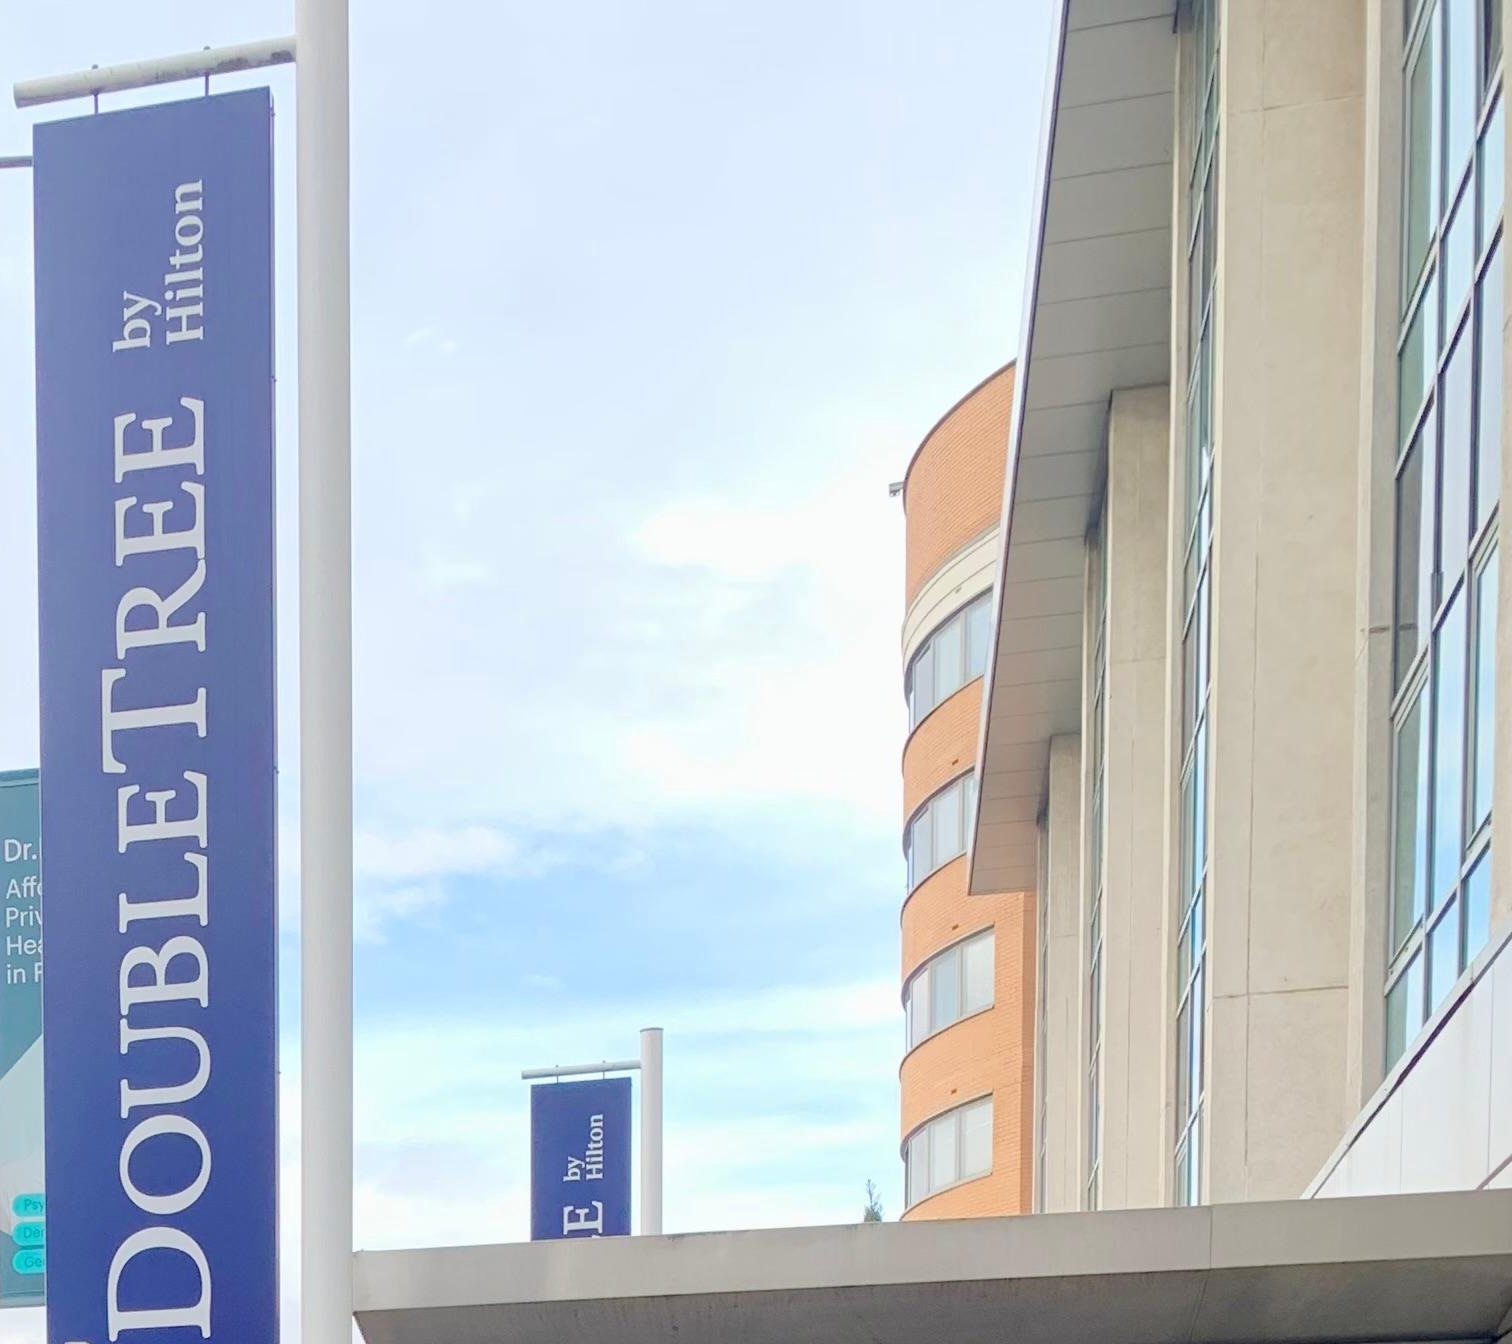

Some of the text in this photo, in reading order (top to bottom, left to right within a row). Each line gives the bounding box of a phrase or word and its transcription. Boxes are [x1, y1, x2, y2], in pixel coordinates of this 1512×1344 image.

[164, 178, 204, 346] Hilton
[112, 290, 162, 353] by
[101, 396, 212, 1344] DOUBLETREE
[5, 875, 42, 900] Aff
[6, 935, 43, 956] He
[6, 963, 26, 984] in
[585, 1113, 604, 1180] Hilton
[563, 1156, 585, 1182] by
[23, 1227, 44, 1239] De
[563, 1200, 604, 1238] E
